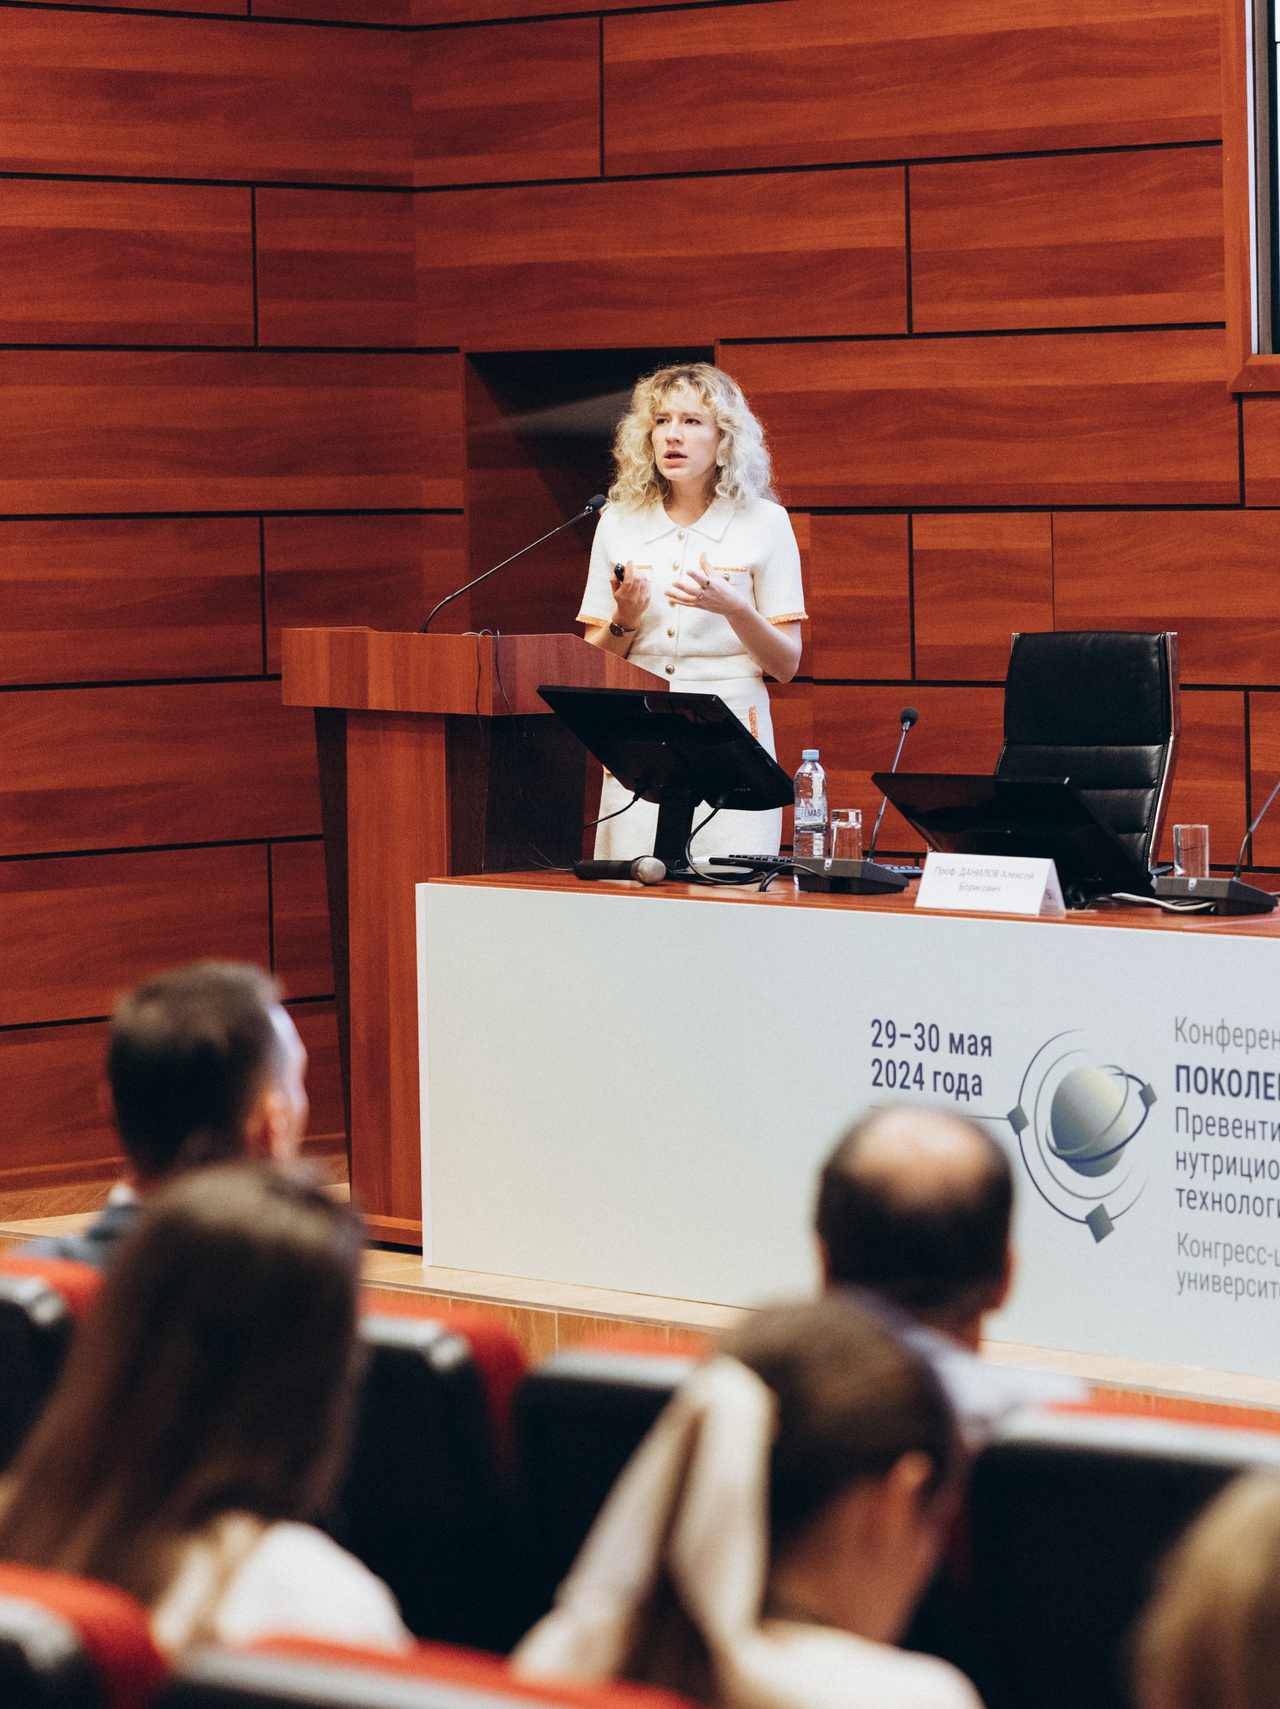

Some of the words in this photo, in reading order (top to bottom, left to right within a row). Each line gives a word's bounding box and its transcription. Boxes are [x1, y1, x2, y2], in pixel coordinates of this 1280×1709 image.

[959, 868, 1000, 879] ДАНИЛОВ
[1001, 870, 1034, 881] Алексей
[959, 882, 1001, 894] Борисович
[949, 1032, 992, 1057] мая
[871, 1058, 925, 1091] 2024
[932, 1070, 983, 1101] года
